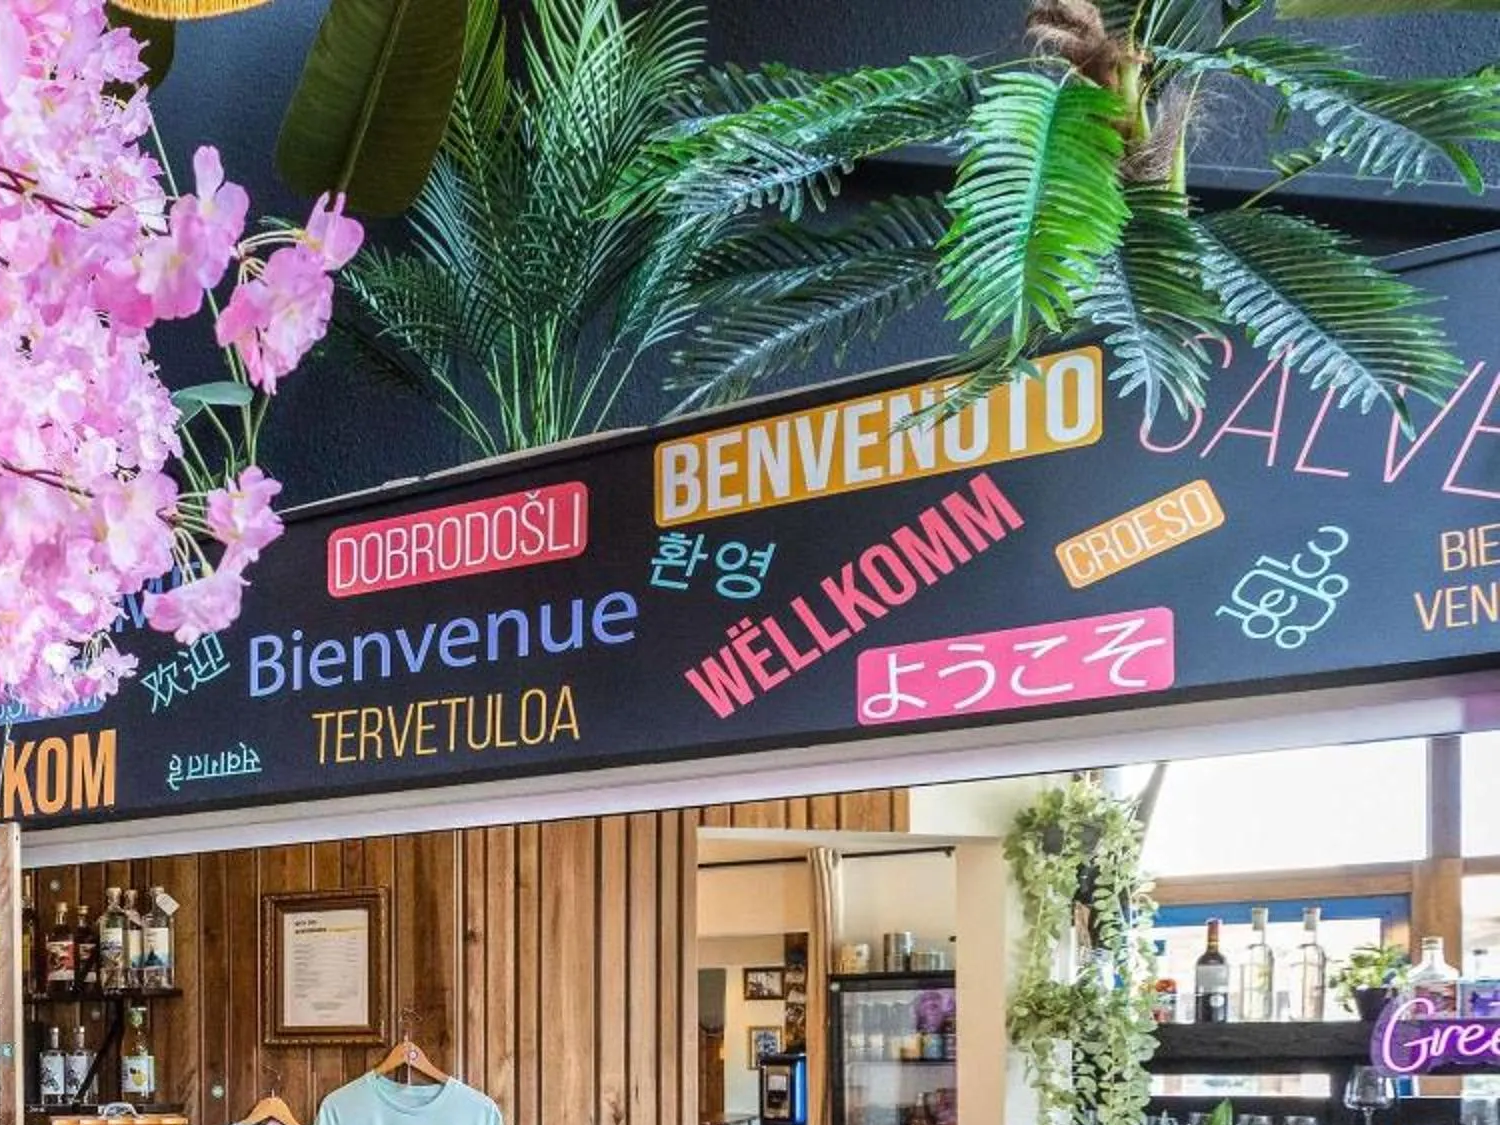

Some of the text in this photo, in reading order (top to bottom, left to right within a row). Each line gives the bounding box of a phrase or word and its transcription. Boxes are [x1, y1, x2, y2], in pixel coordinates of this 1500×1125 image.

[661, 355, 1098, 520] BENVENUTO
[334, 489, 581, 590] DOBRODOŠLI
[649, 530, 776, 600] 환영
[1063, 486, 1214, 580] CROESO
[248, 590, 639, 698] Bienvenue
[684, 472, 1025, 719] WËLLKOMM
[1413, 581, 1500, 632] VEN
[140, 631, 231, 713] 欢迎
[862, 617, 1168, 719] ようこそ
[311, 685, 581, 766] TERVETULOA
